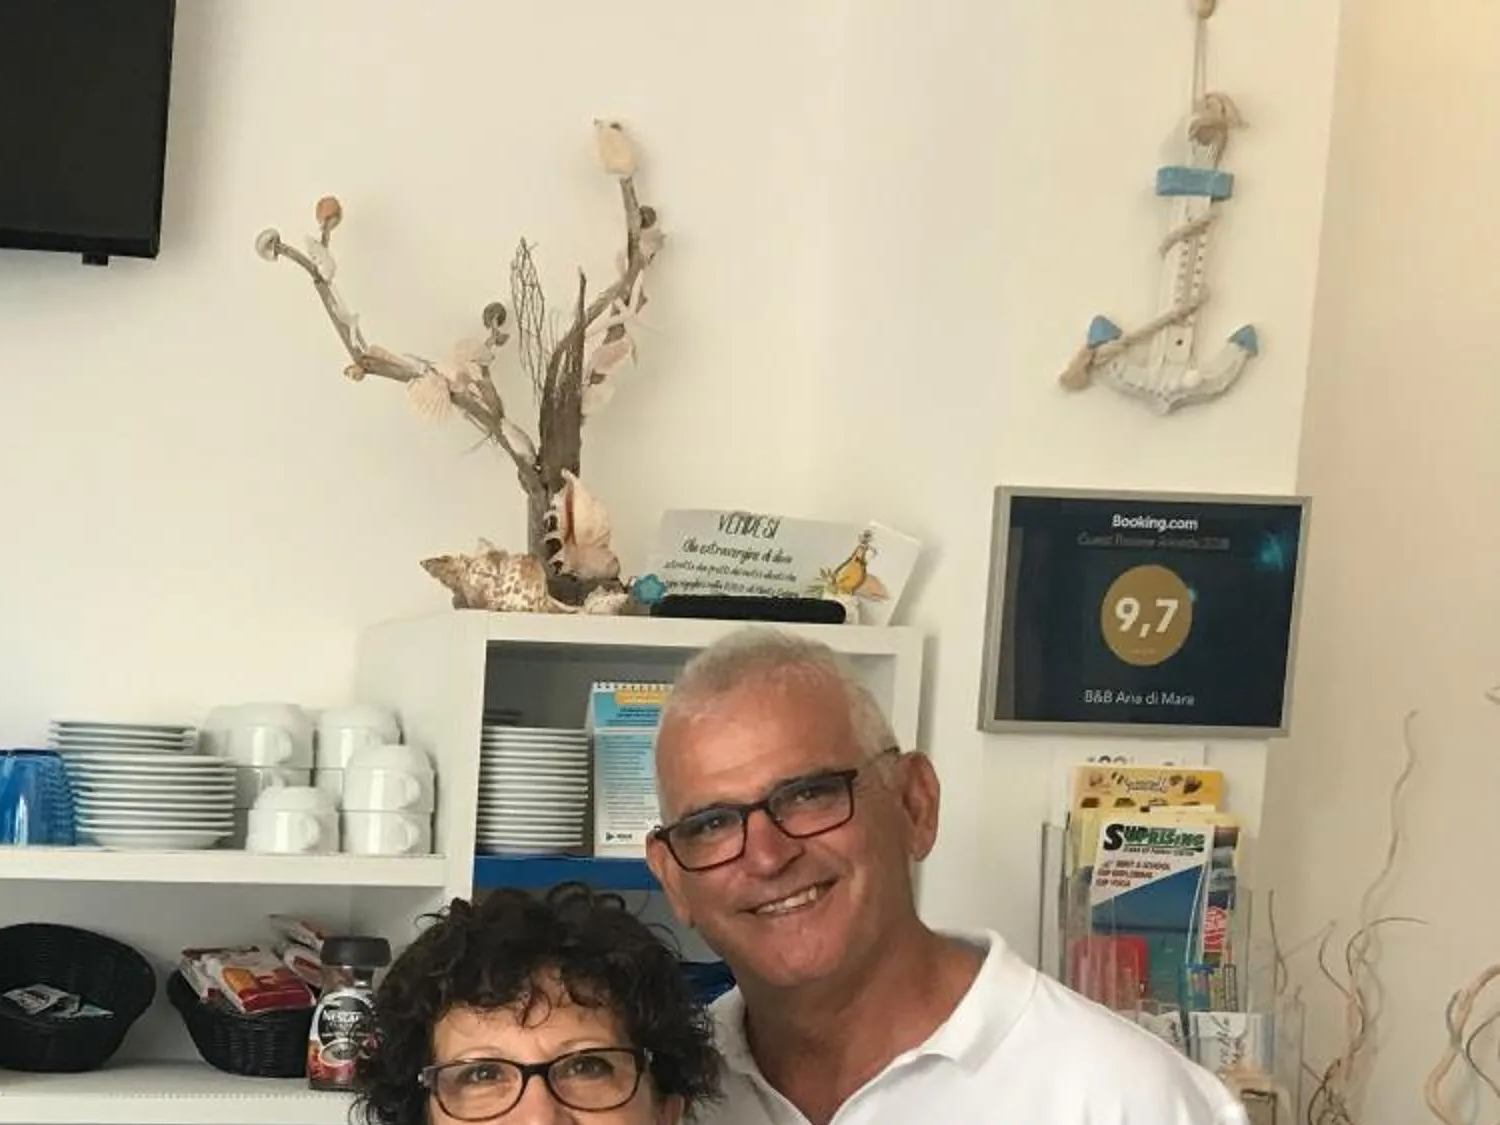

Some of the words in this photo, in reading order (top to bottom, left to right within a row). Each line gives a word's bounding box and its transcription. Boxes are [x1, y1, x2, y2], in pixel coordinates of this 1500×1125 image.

[1112, 514, 1199, 533] Booking.com
[1114, 597, 1179, 638] 9,7
[1085, 690, 1113, 704] B&B
[1116, 691, 1142, 705] Aria
[1146, 691, 1158, 705] di
[1162, 692, 1195, 706] Mare
